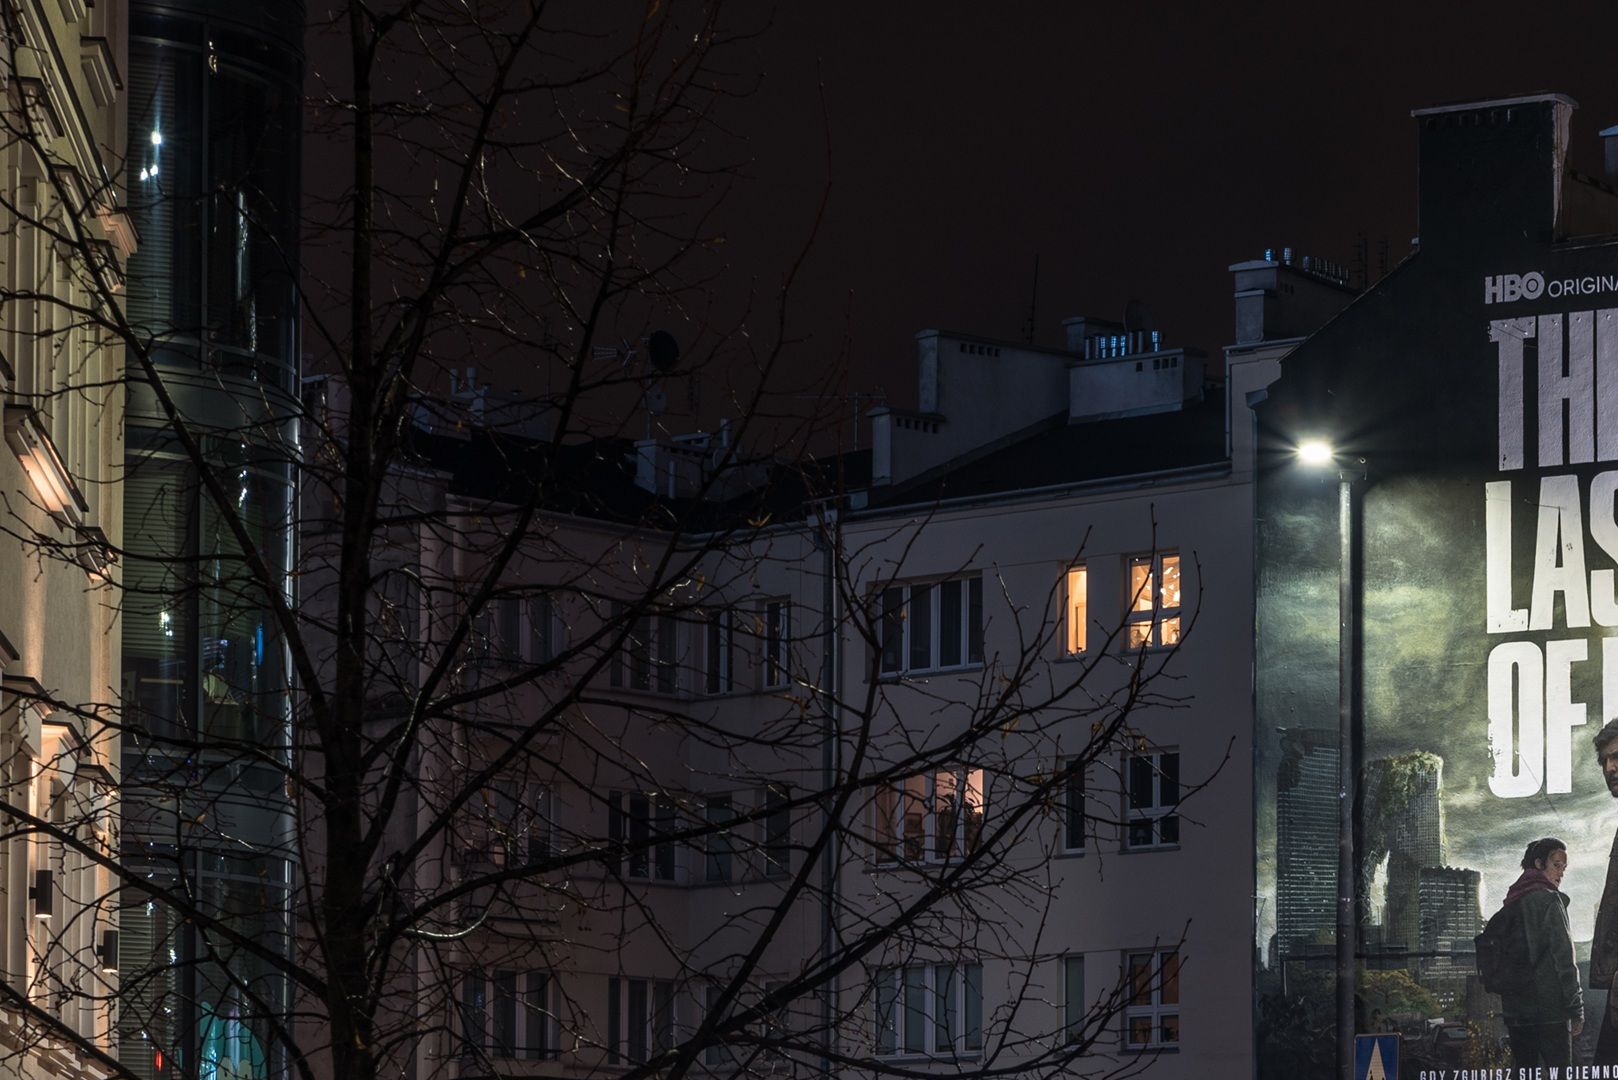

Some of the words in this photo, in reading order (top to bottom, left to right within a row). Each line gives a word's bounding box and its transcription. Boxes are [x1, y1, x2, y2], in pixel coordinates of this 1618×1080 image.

[1485, 271, 1545, 304] HBO
[1487, 639, 1589, 799] OF
[1549, 1066, 1559, 1080] W
